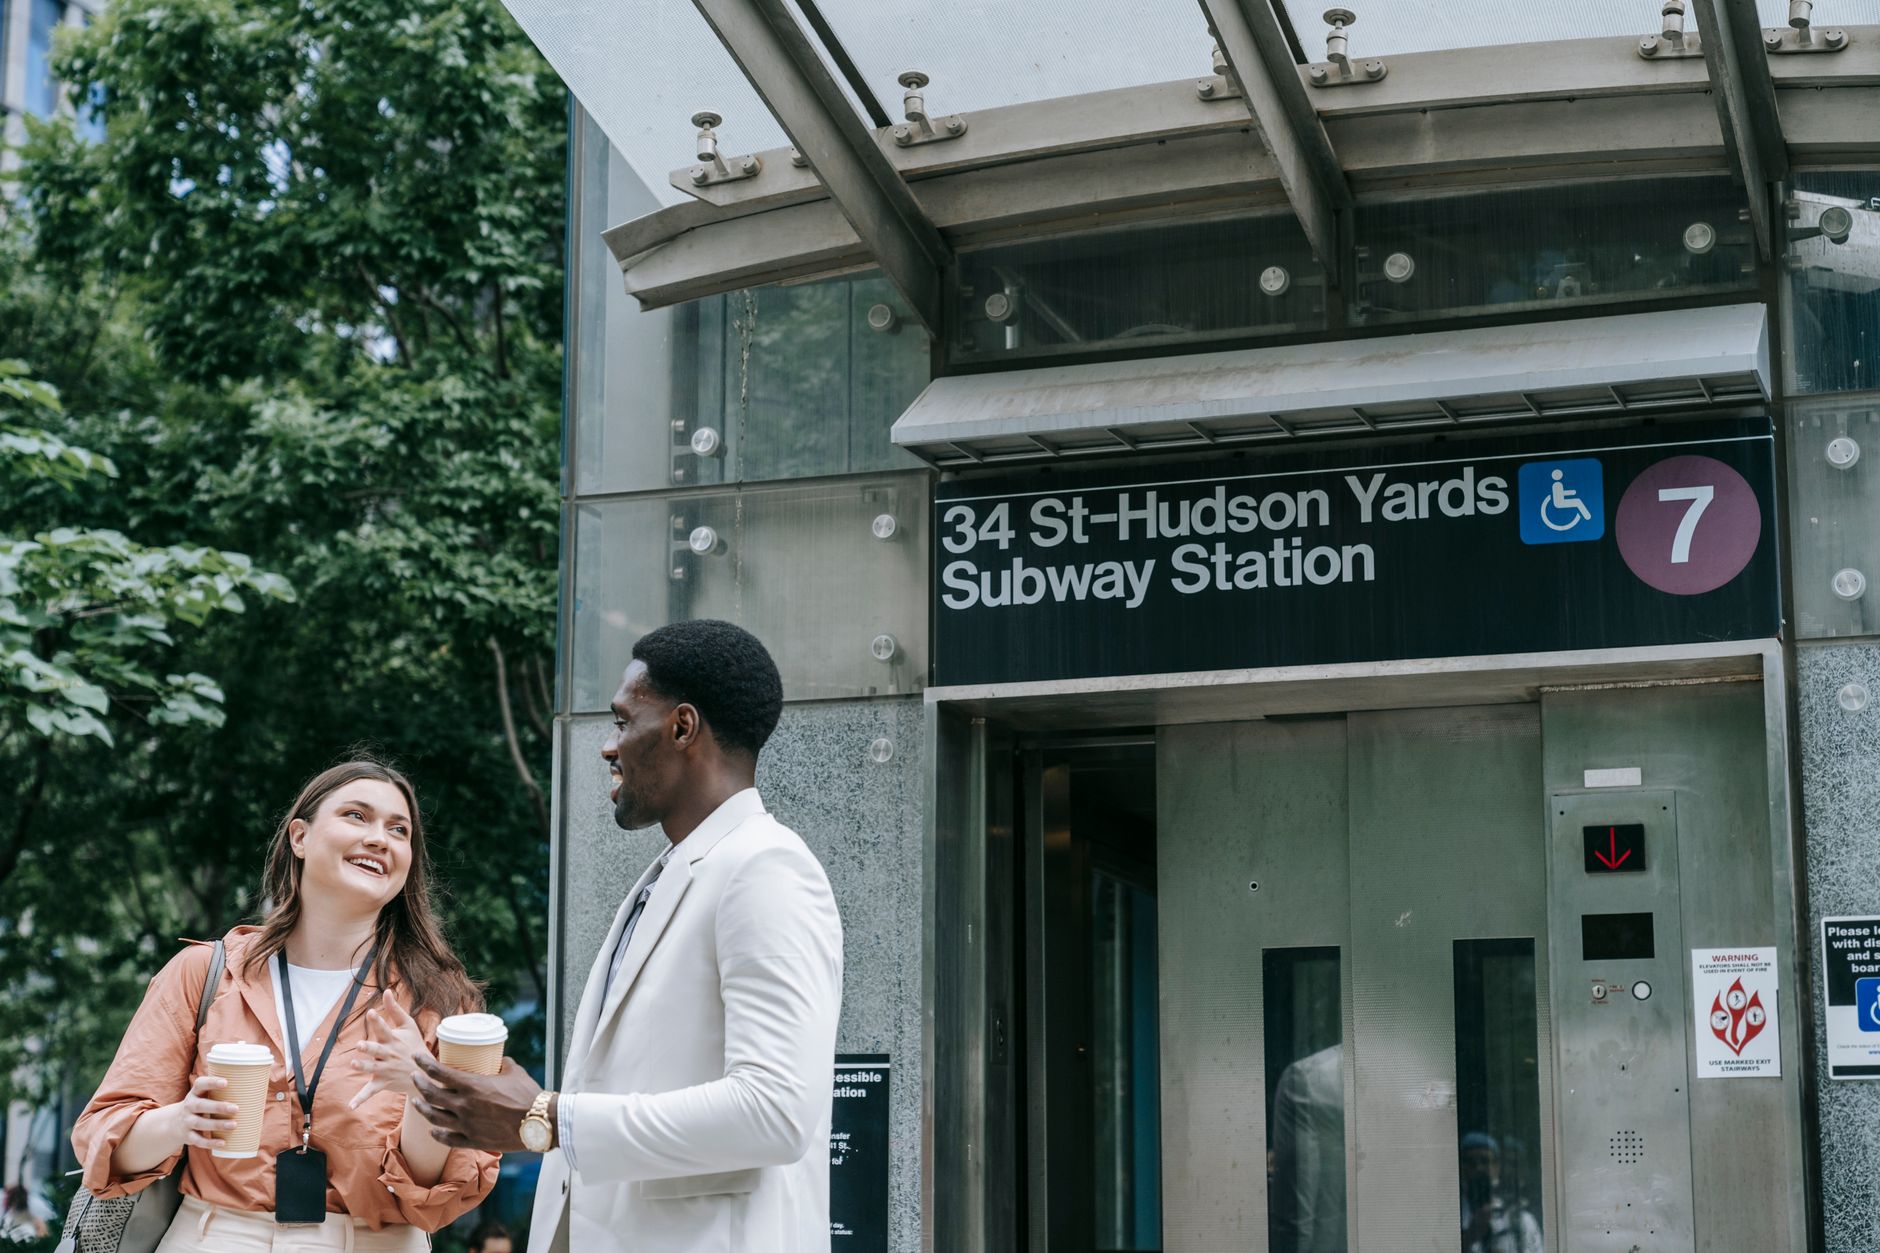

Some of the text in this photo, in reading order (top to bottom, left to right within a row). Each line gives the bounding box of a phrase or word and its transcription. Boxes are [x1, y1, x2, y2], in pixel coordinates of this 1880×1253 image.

[942, 503, 1015, 554] 34
[1344, 466, 1510, 523] Yards
[1658, 485, 1714, 563] 7
[942, 537, 1375, 610] Subway Station
[1827, 926, 1870, 937] Please
[1832, 938, 1860, 949] with
[1711, 953, 1759, 962] WARNING
[1846, 950, 1870, 961] and
[833, 1071, 882, 1083] essible
[833, 1086, 867, 1098] ation
